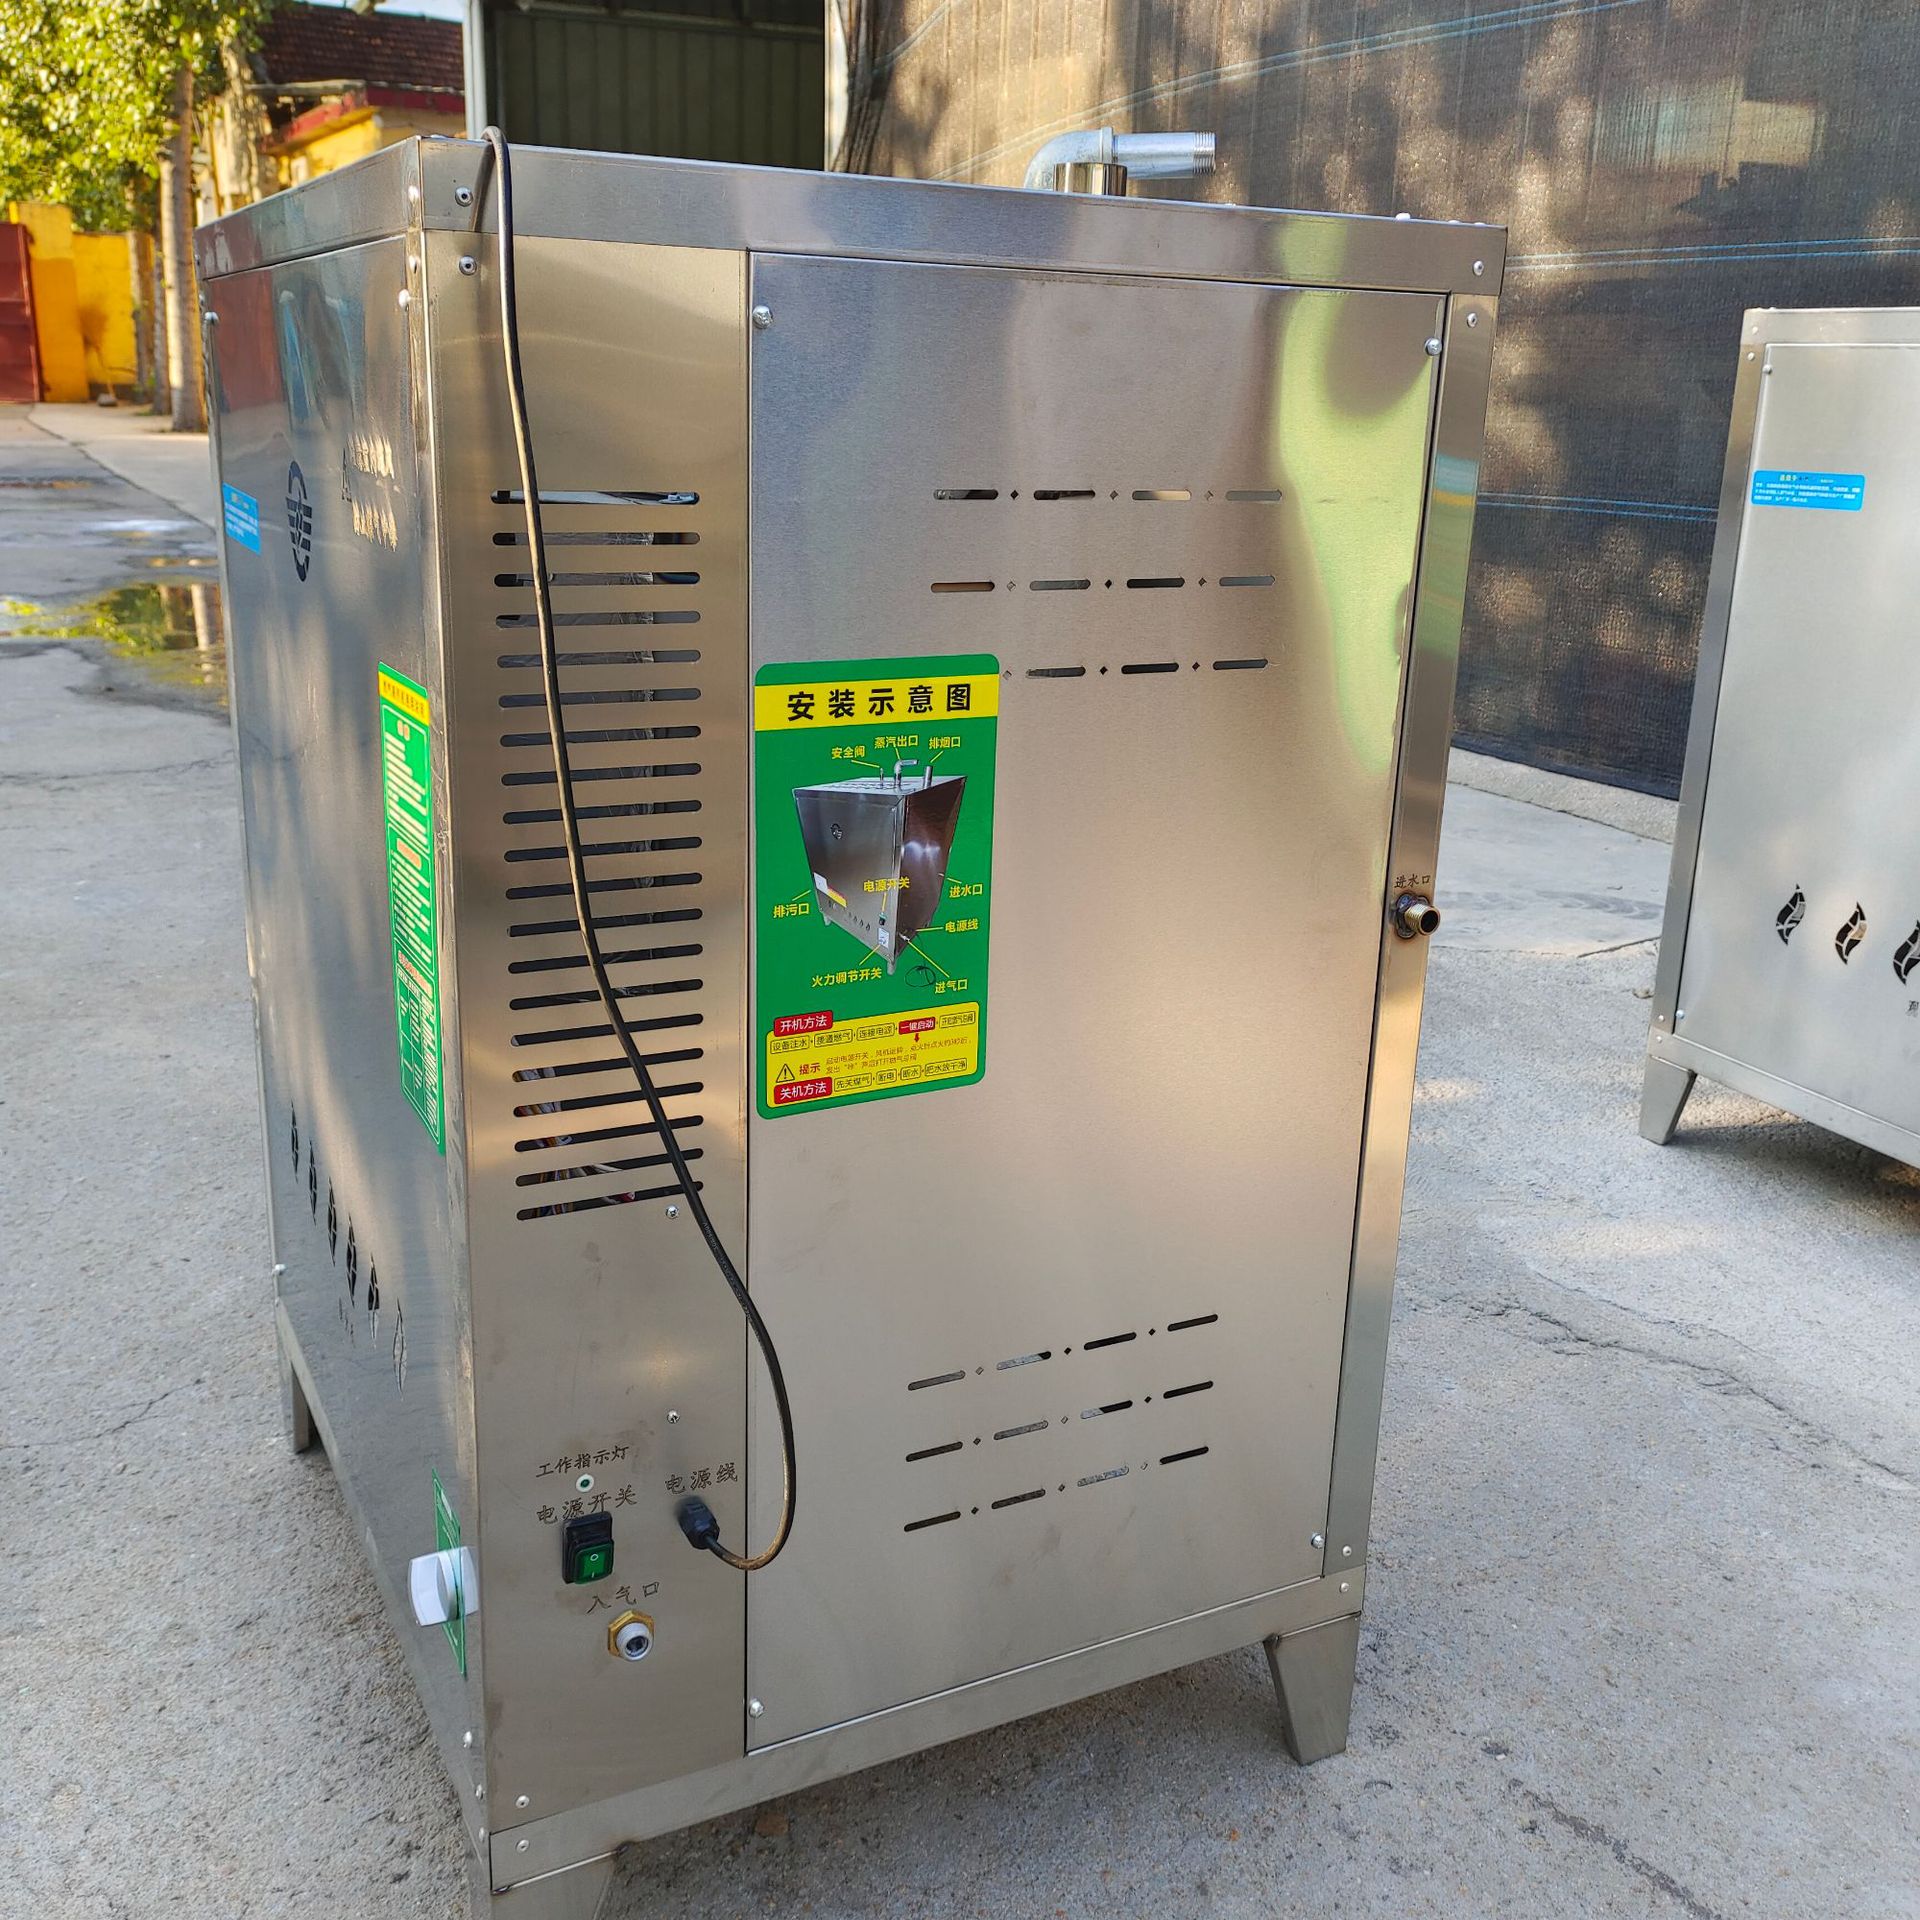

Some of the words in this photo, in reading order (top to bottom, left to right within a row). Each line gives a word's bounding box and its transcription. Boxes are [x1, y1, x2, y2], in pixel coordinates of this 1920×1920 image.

[788, 683, 971, 721] 安装示意图
[928, 736, 961, 750] 排烟口
[831, 745, 865, 759] 安全阀
[863, 876, 910, 892] 电源开关
[1394, 873, 1431, 888] 进水口
[949, 883, 983, 898] 进水口
[772, 903, 809, 918] 排污口
[945, 918, 978, 933] 电源线
[811, 968, 882, 988] 火力调节开关
[934, 979, 968, 995] 进气口
[780, 1015, 827, 1033] 开机方法
[799, 1062, 821, 1075] 提示
[780, 1082, 827, 1100] 关机方法
[535, 1445, 630, 1478] 工作指示灯
[664, 1462, 738, 1495] 电源线
[537, 1484, 637, 1526] 电源开关
[586, 1580, 660, 1614] 入气口
